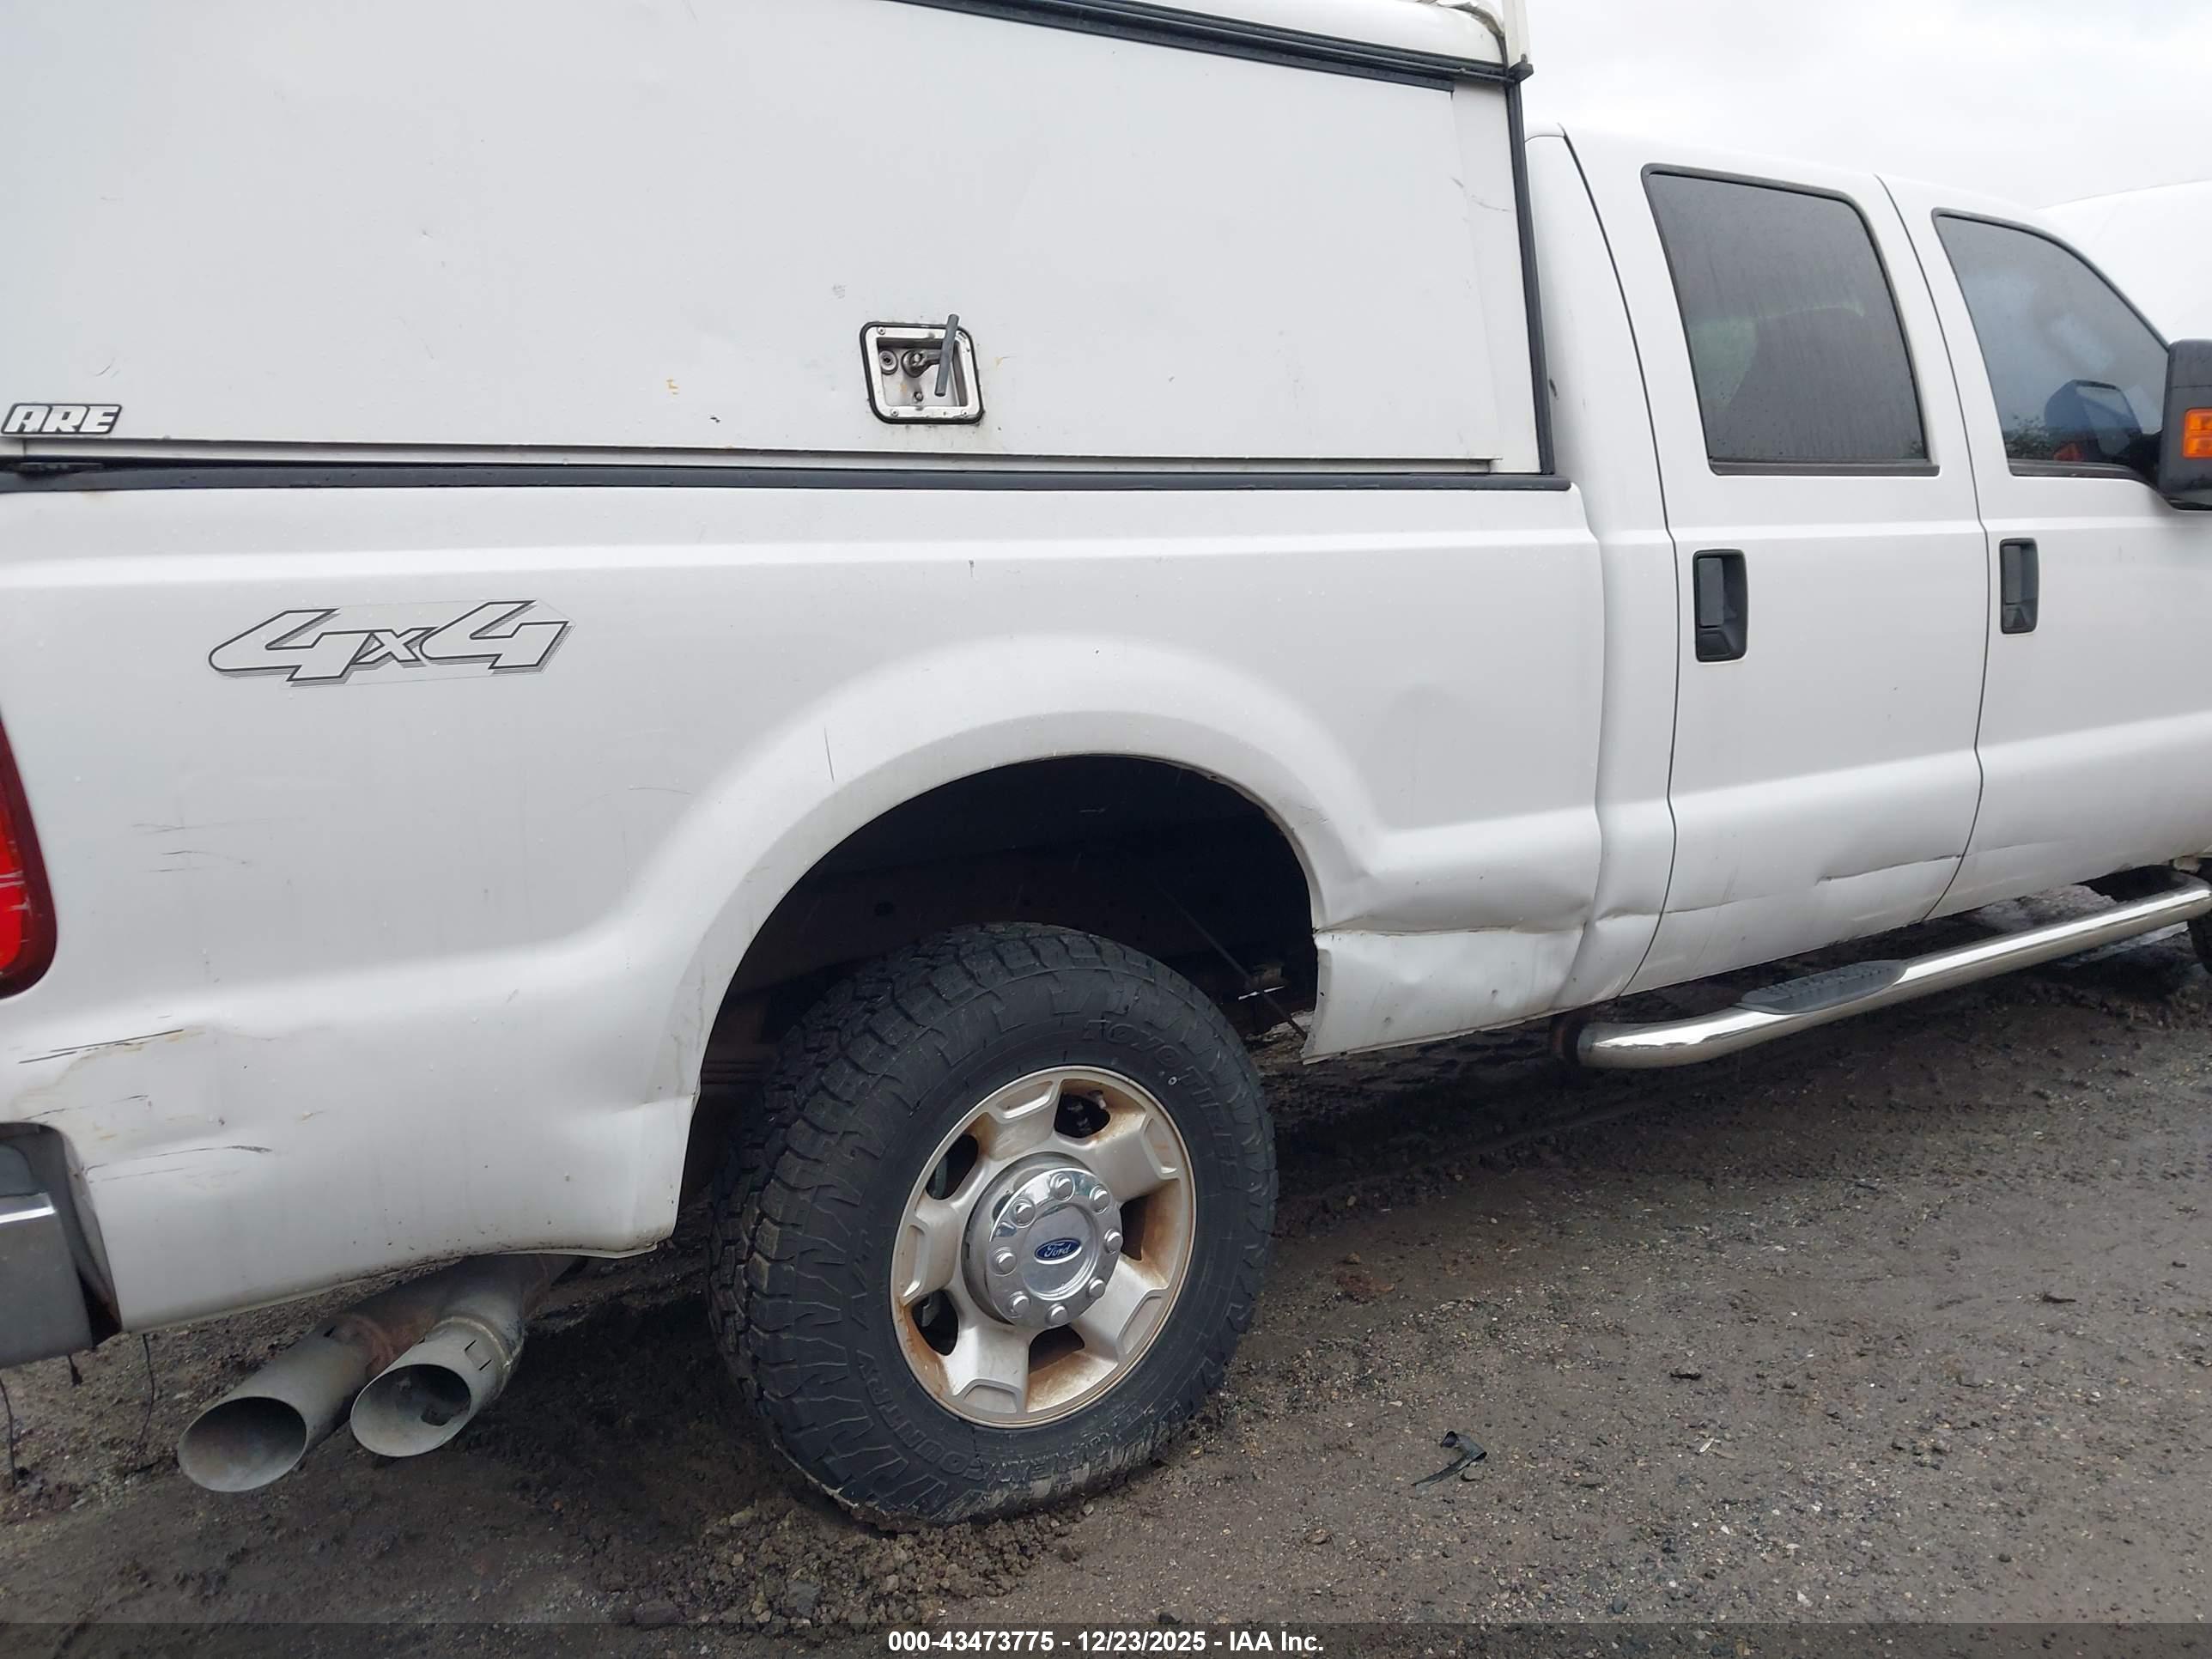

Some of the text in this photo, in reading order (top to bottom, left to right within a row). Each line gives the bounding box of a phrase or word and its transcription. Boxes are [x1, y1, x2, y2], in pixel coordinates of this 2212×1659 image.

[2, 404, 122, 434] ARE
[209, 599, 570, 686] 4x4
[1082, 1018, 1184, 1068] TOYO
[855, 1348, 986, 1482] COUNTRY
